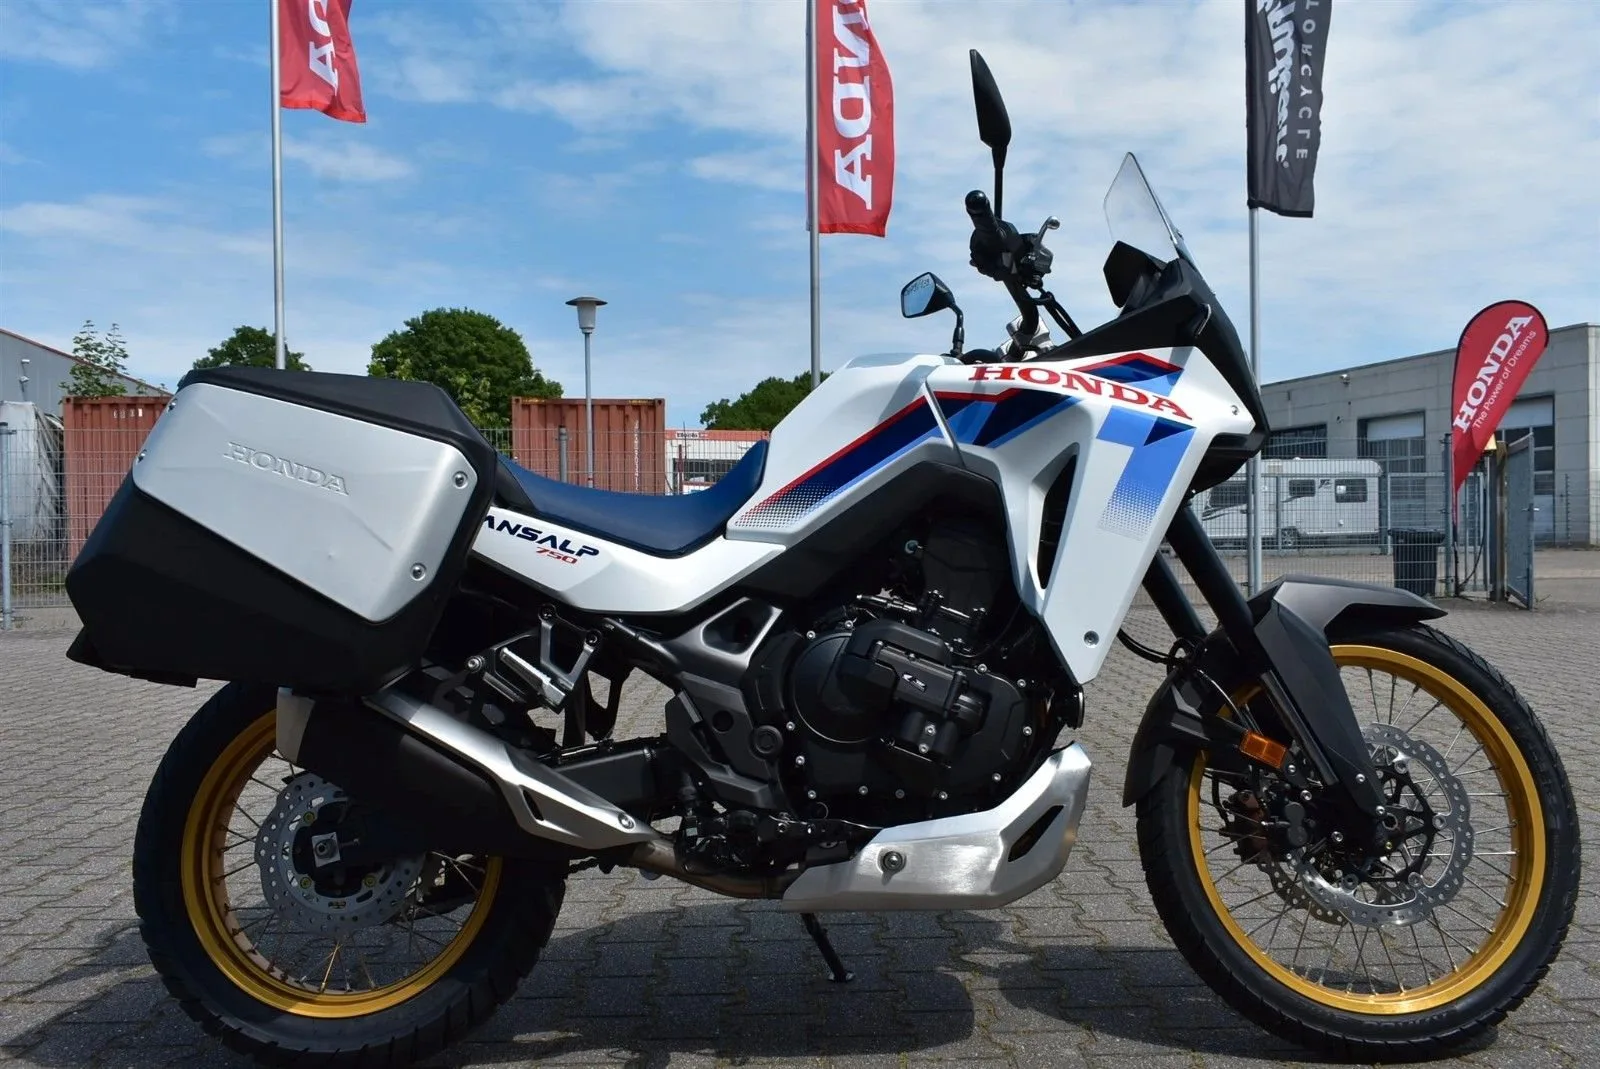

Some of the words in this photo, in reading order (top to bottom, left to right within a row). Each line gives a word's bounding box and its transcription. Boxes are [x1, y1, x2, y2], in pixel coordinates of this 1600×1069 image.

[968, 366, 1193, 421] HONDA
[1453, 315, 1533, 433] HONDA
[1472, 411, 1488, 429] The
[1483, 380, 1505, 410] Power
[1502, 366, 1512, 380] of
[1507, 331, 1537, 367] Dreams
[222, 441, 349, 496] HONDA
[536, 547, 578, 564] 750
